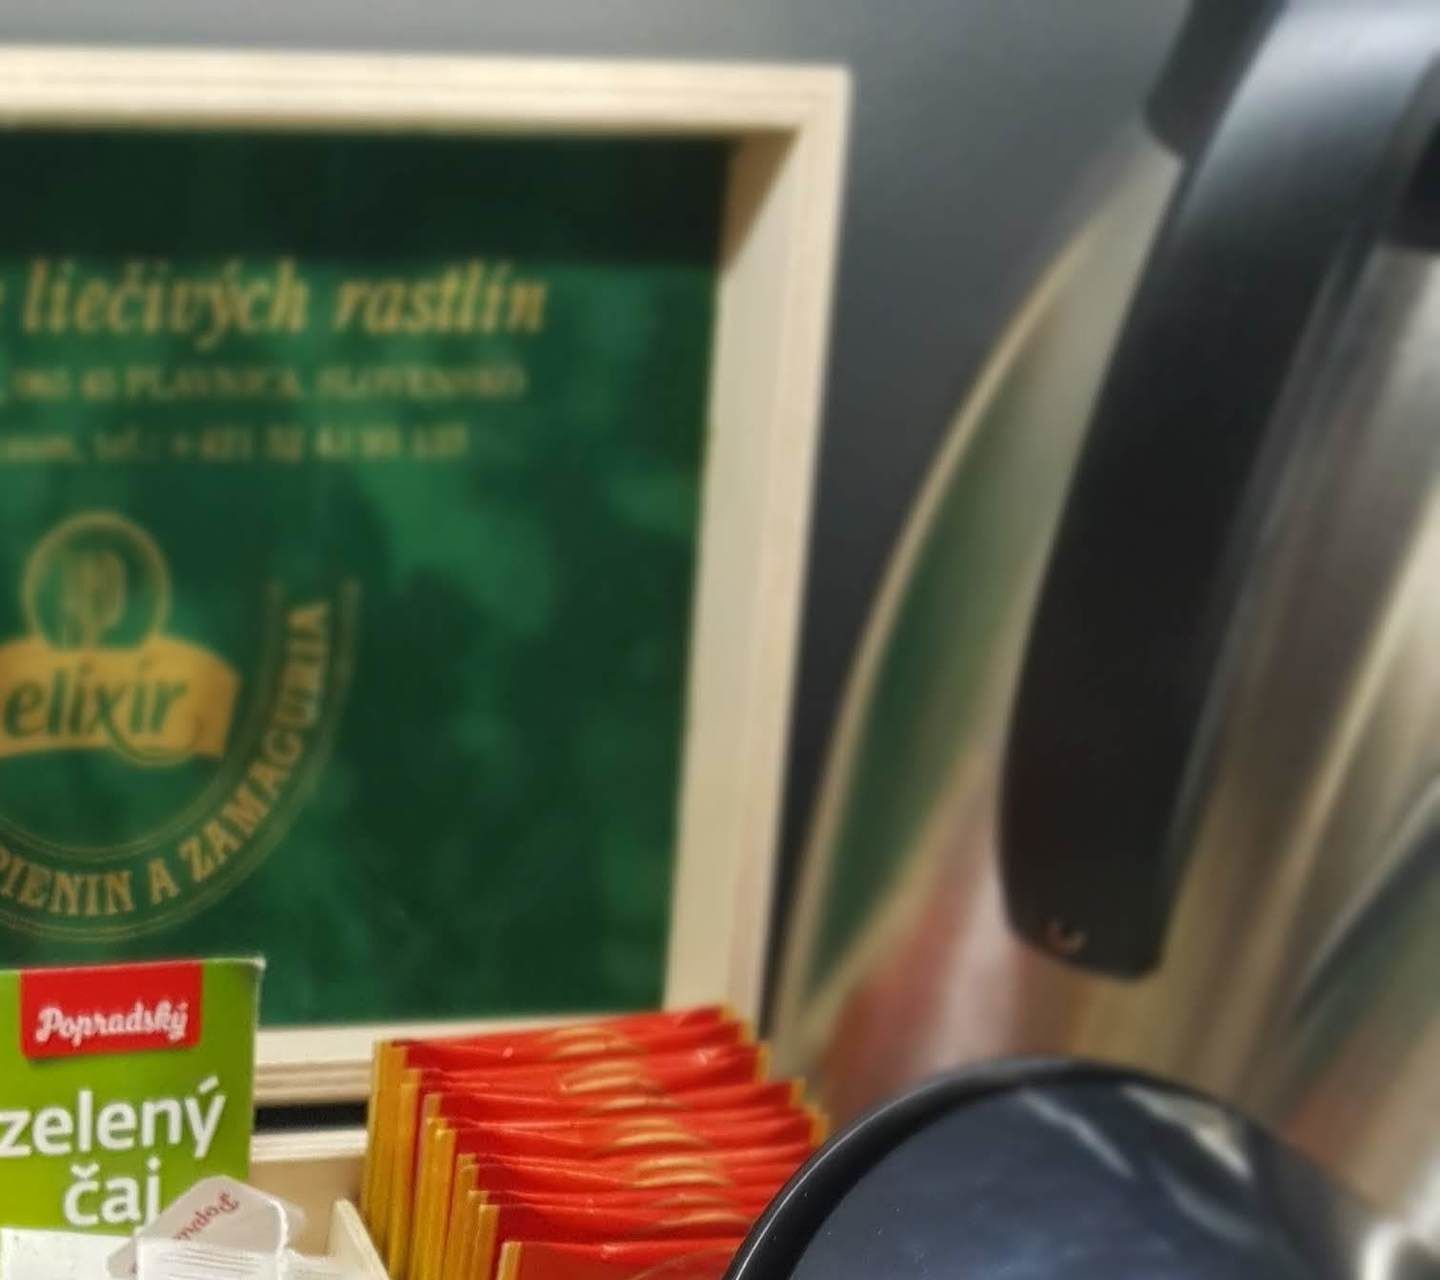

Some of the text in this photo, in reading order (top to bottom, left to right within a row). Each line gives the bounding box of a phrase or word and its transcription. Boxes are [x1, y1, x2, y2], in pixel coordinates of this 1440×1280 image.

[22, 255, 310, 354] liečivých
[332, 257, 552, 335] rastlín
[3, 658, 190, 744] elixir
[148, 857, 183, 907] A
[34, 1000, 190, 1047] Popradský
[62, 1156, 161, 1228] čaj
